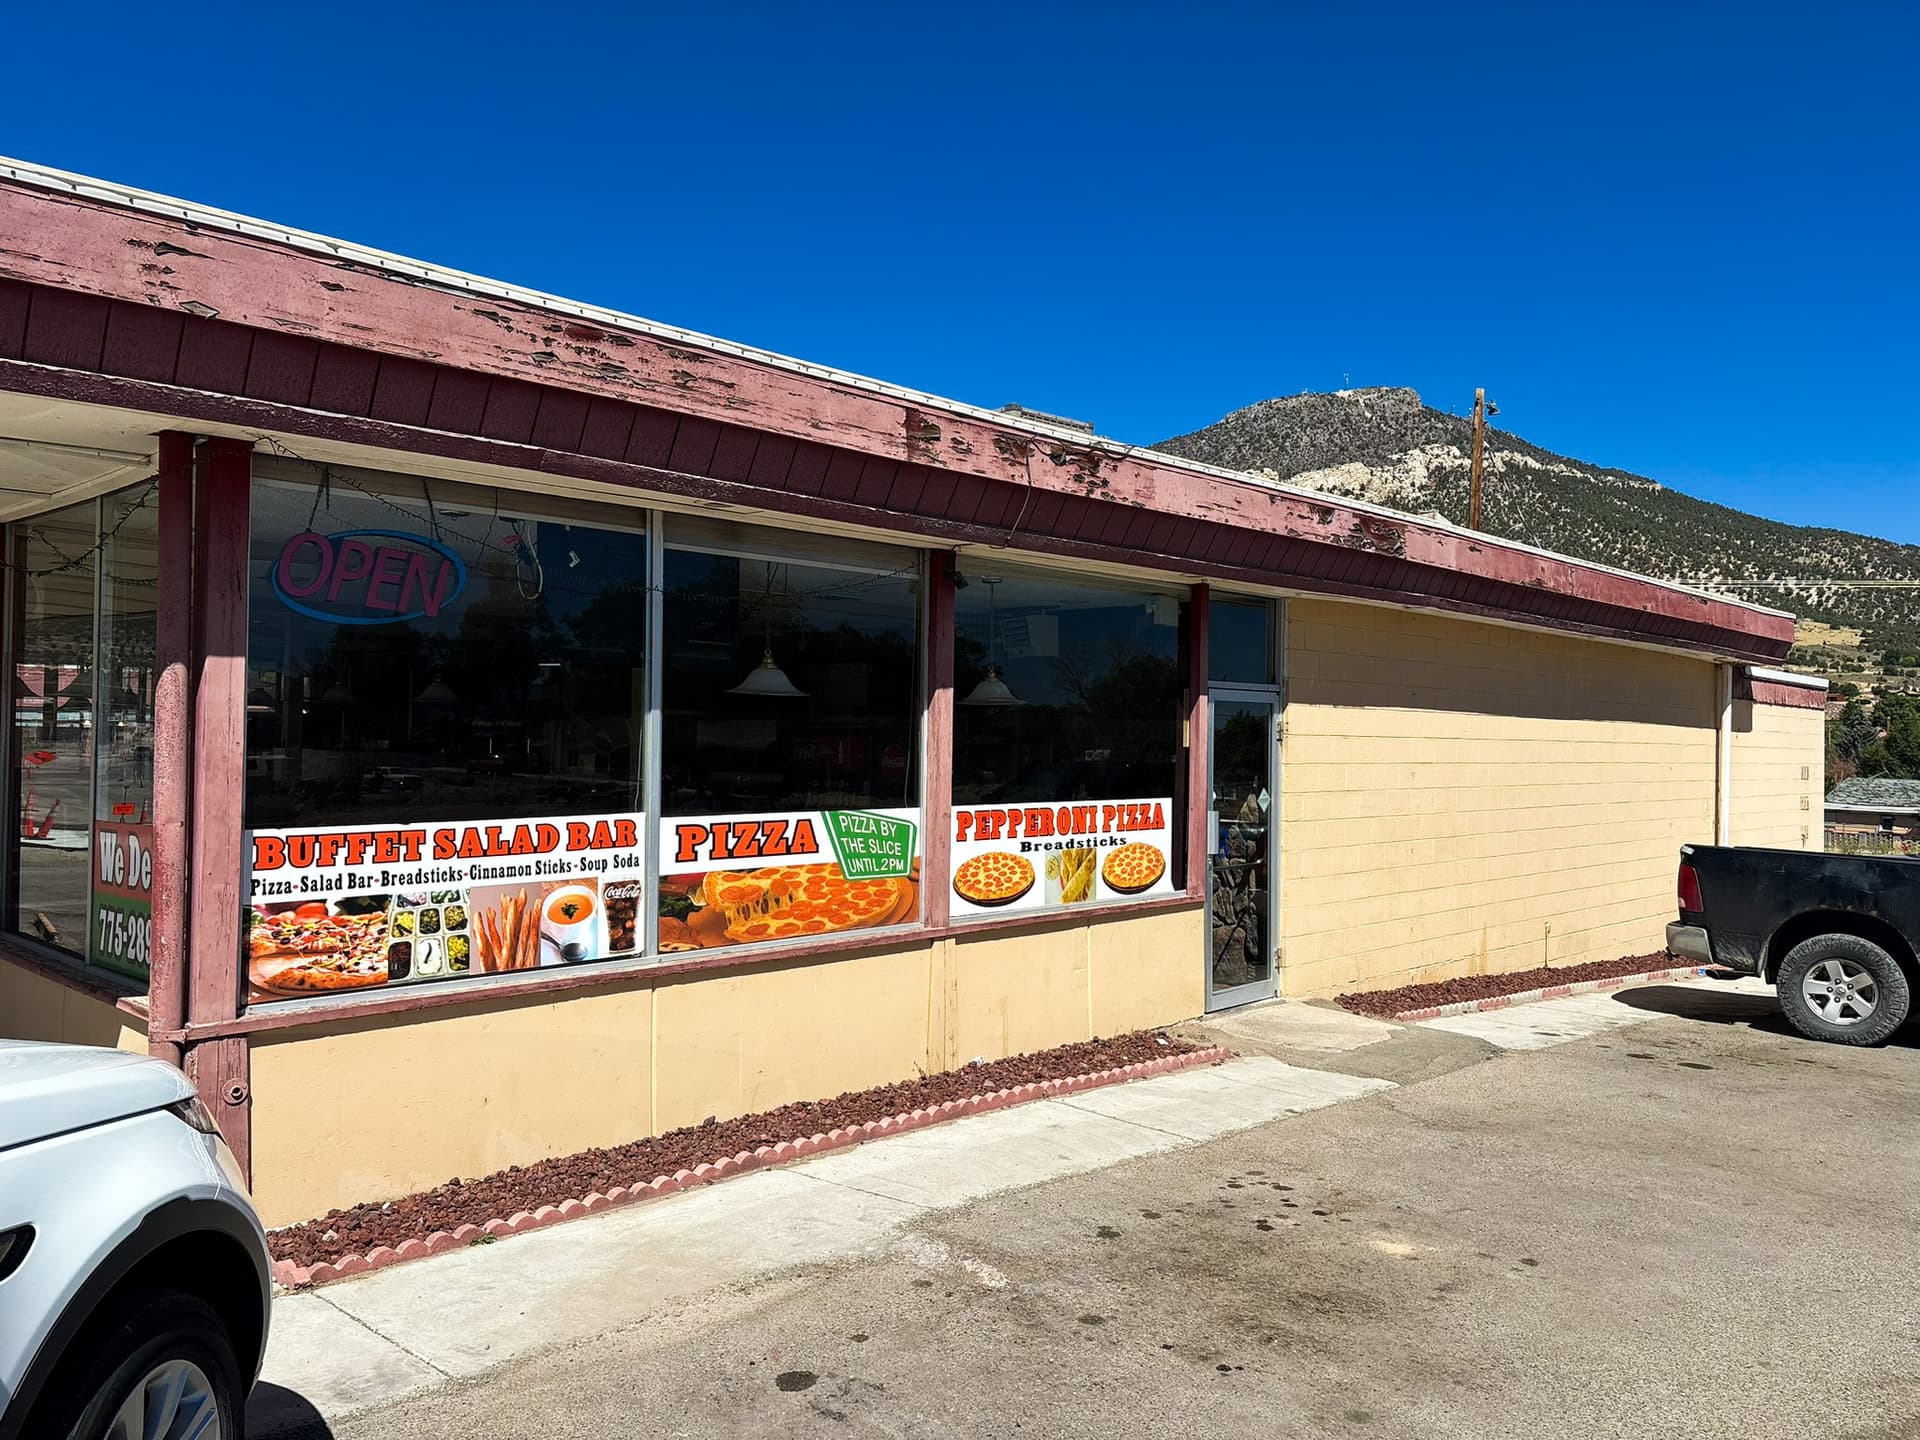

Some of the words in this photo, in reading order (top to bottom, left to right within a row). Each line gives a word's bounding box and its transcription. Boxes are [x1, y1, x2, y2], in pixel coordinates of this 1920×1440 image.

[278, 531, 451, 617] OPEN
[839, 815, 877, 835] PIZZA
[881, 822, 898, 838] BY
[956, 805, 1098, 842] PEPPERONI
[1102, 802, 1165, 833] PIZZA
[253, 830, 426, 871] BUFFET
[433, 822, 560, 860] SALAD
[566, 819, 637, 851] BAR
[675, 819, 819, 862] PIZZA
[840, 837, 865, 855] THE
[869, 839, 902, 856] SLICE
[1020, 836, 1127, 853] Breadsticks
[99, 831, 125, 886] We
[613, 852, 640, 869] Soda
[848, 858, 879, 873] UNTIL
[880, 858, 904, 872] 2PM
